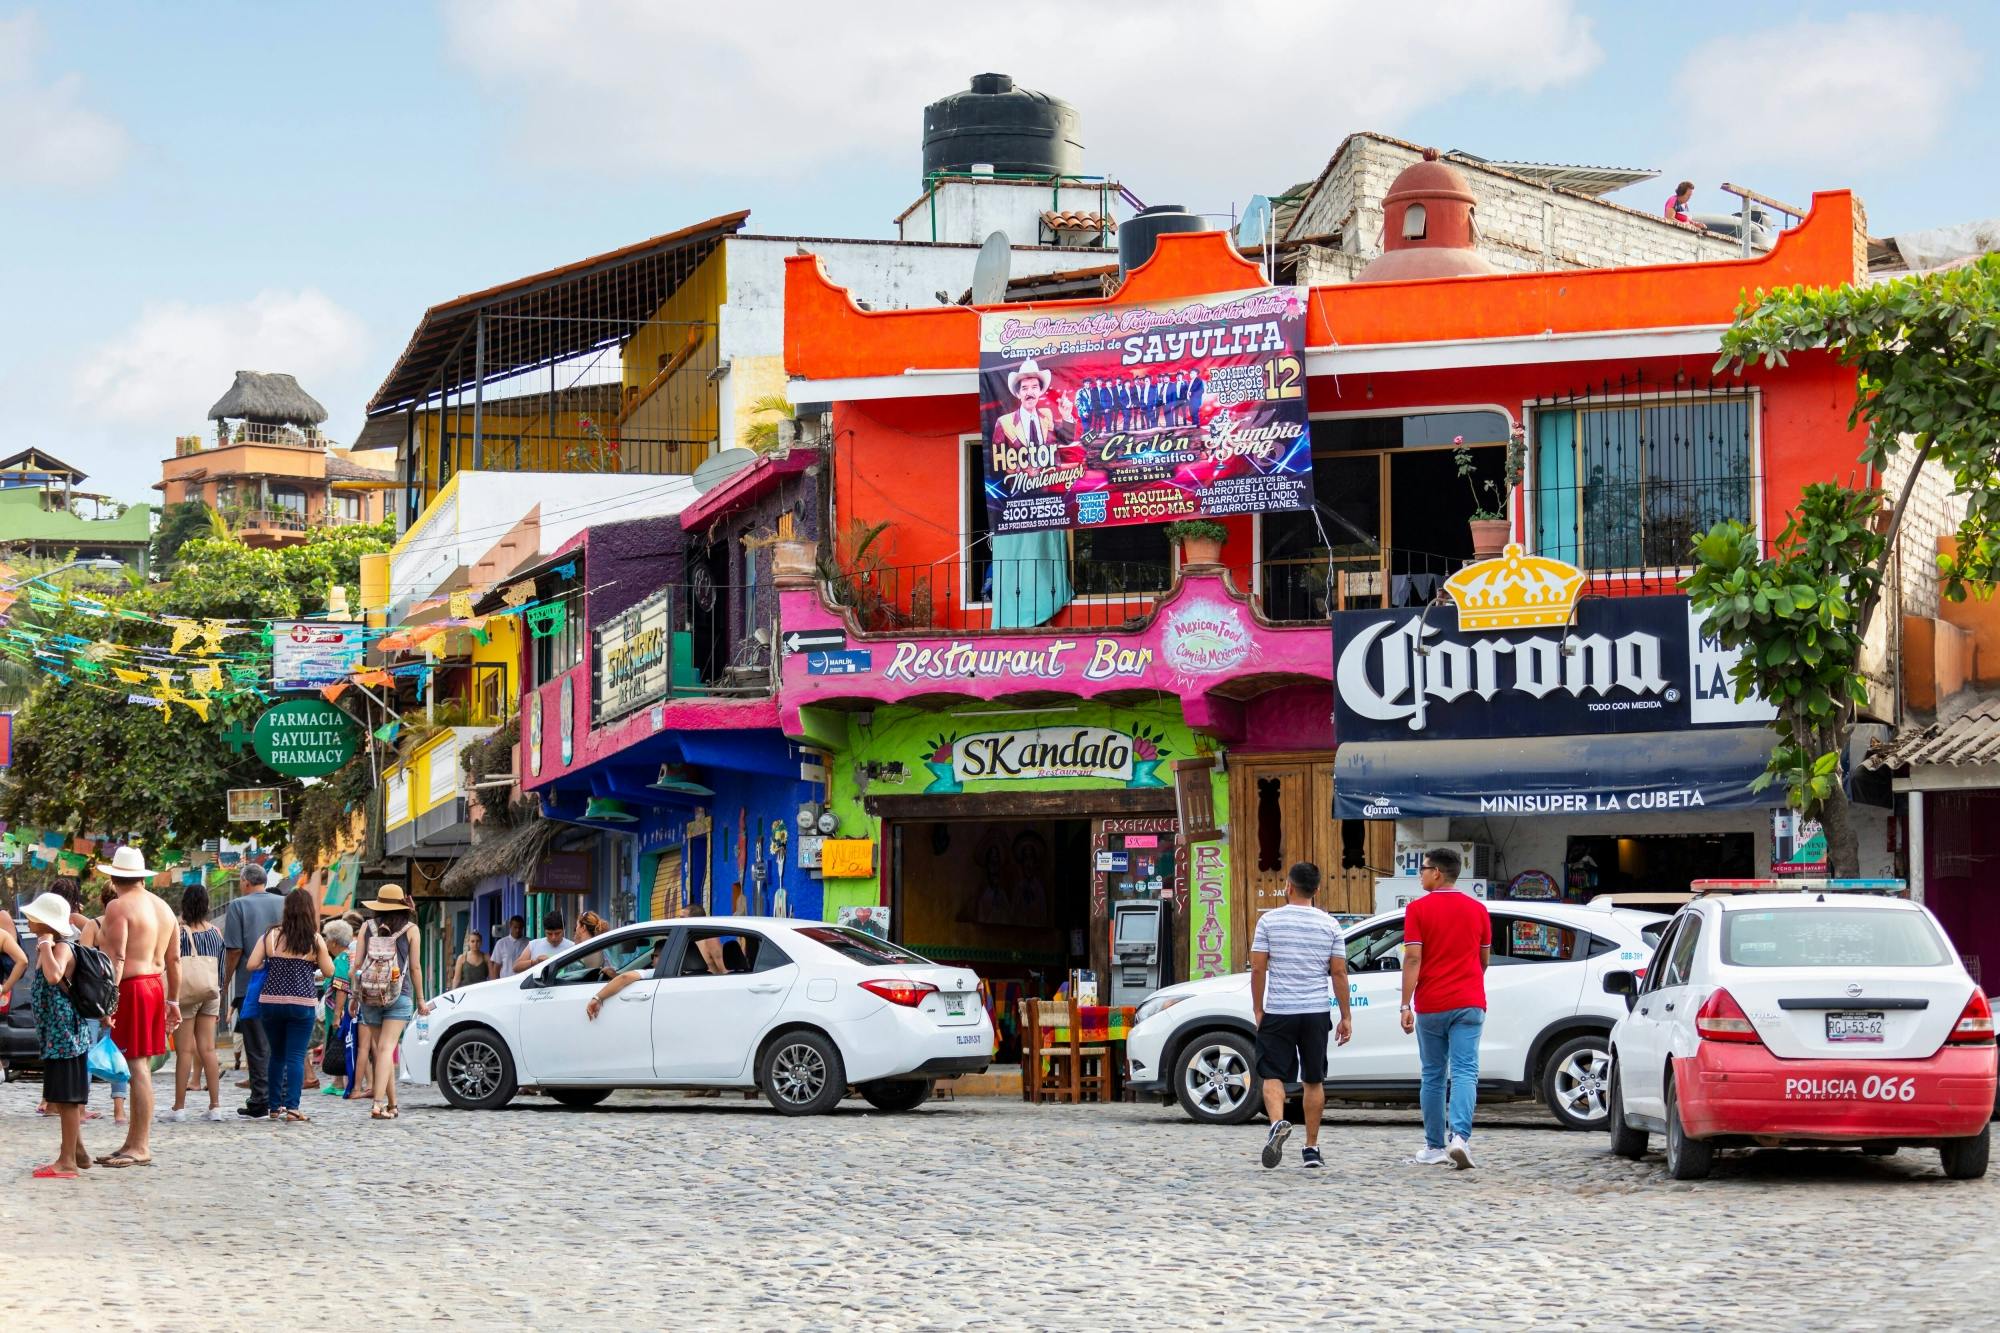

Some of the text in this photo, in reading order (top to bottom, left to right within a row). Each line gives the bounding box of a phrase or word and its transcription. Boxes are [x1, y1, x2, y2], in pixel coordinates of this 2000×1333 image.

[1001, 338, 1121, 359] Campo de Beisbol de
[1122, 321, 1285, 365] SAYULITA
[1210, 365, 1263, 381] DOMINGO
[1264, 357, 1302, 400] 12
[1219, 388, 1265, 404] 8:00 PM
[1085, 431, 1097, 443] EL
[1101, 433, 1189, 461] Ciclón
[992, 441, 1058, 472] Hector
[1132, 457, 1146, 465] Del
[1004, 464, 1085, 495] Montemayor
[1246, 476, 1276, 485] BOLETOS
[1123, 489, 1183, 505] TAQUILLA
[1195, 485, 1251, 497] ABARROTES
[1252, 483, 1264, 492] LA
[1201, 494, 1256, 506] ABARROTES
[1258, 492, 1269, 500] EL
[1002, 503, 1066, 520] $100 PESOS
[1113, 501, 1195, 519] UN POCO MAS
[1210, 502, 1265, 514] ABARROTES
[1174, 618, 1243, 642] Mexican Food
[884, 639, 1153, 684] Restaurant Bar
[1176, 642, 1208, 665] Comida
[1337, 615, 1671, 731] Corona
[1695, 662, 1730, 700] LA
[1588, 701, 1662, 712] TODO CON MEDIDA
[269, 712, 344, 727] FARMACIA
[271, 732, 342, 747] SAYULITA
[271, 750, 344, 764] PHARMACY
[962, 730, 1130, 776] SKandalo
[1037, 767, 1094, 778] Restaurant
[1480, 789, 1705, 813] MINISUPER LA CUBETA
[1362, 804, 1401, 818] Corona
[1829, 1021, 1882, 1034] RGJ-53-62
[1786, 1075, 1915, 1101] POLICIA 066
